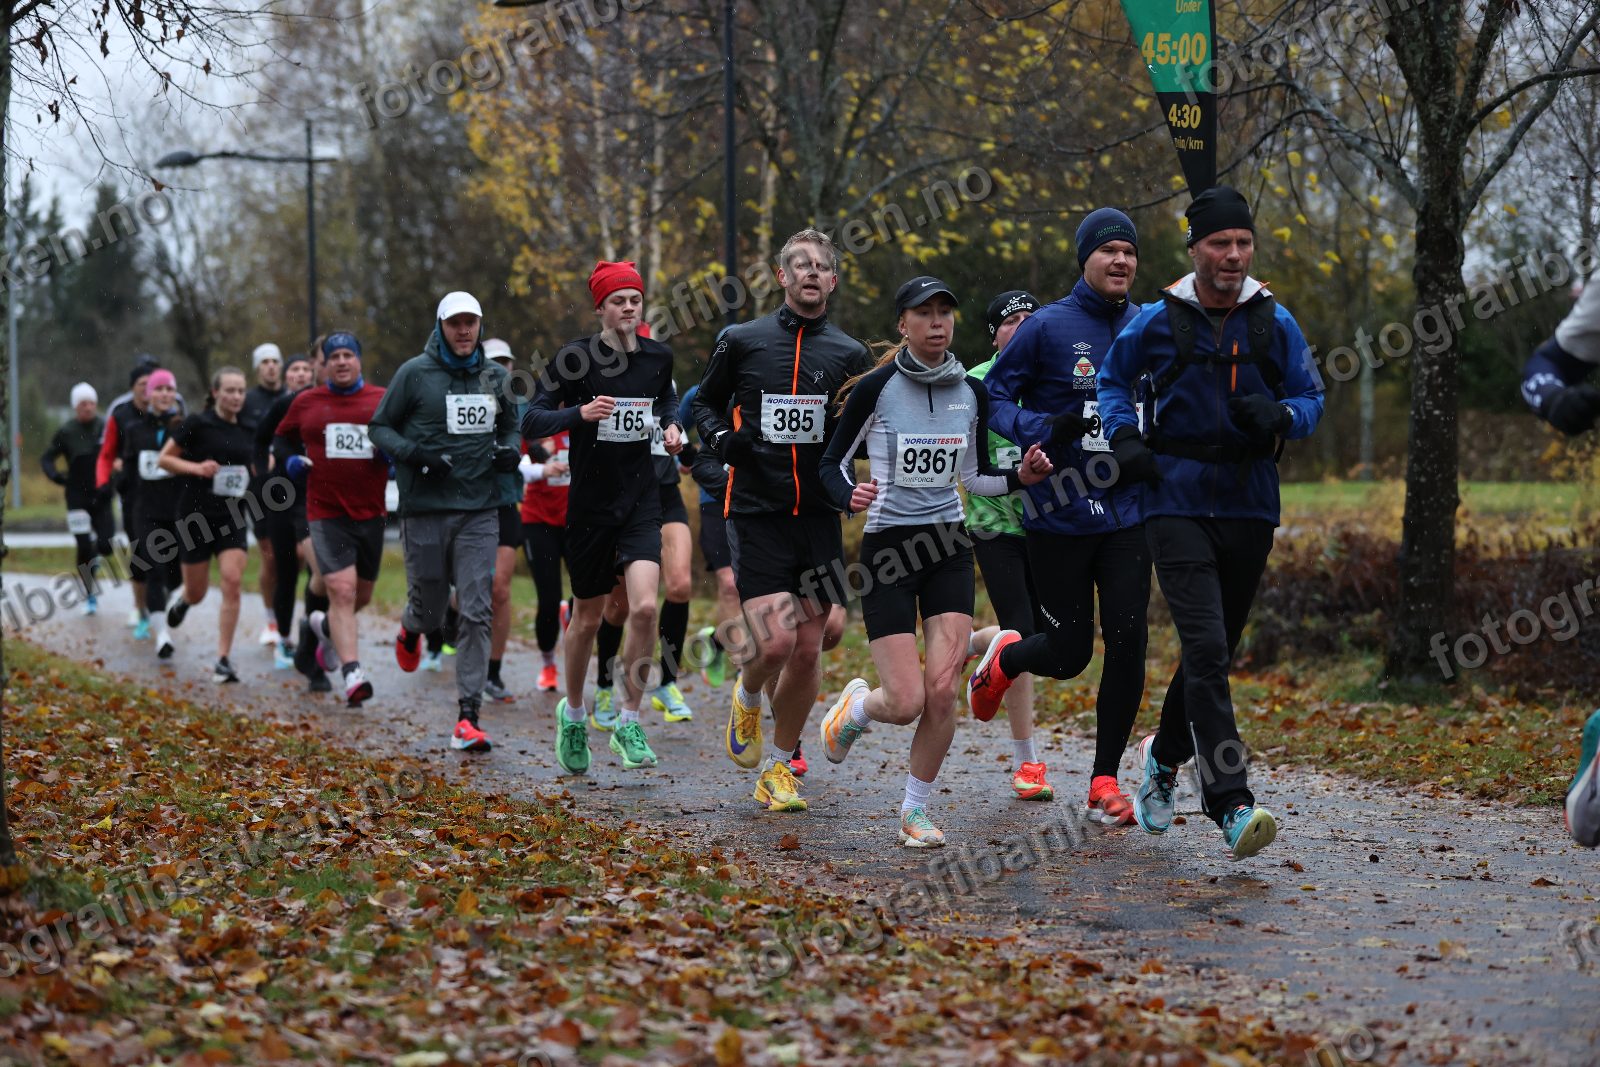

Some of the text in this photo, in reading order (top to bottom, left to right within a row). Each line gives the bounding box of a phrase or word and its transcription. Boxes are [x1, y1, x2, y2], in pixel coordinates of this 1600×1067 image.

[1176, 0, 1201, 13] Under
[1141, 32, 1207, 65] 45:00
[1168, 104, 1201, 129] 4:30
[457, 406, 487, 425] 562
[612, 410, 645, 431] 165
[773, 408, 814, 432] 385
[336, 434, 363, 450] 824
[904, 437, 962, 445] NORGESTESTEN
[903, 447, 958, 474] 9361
